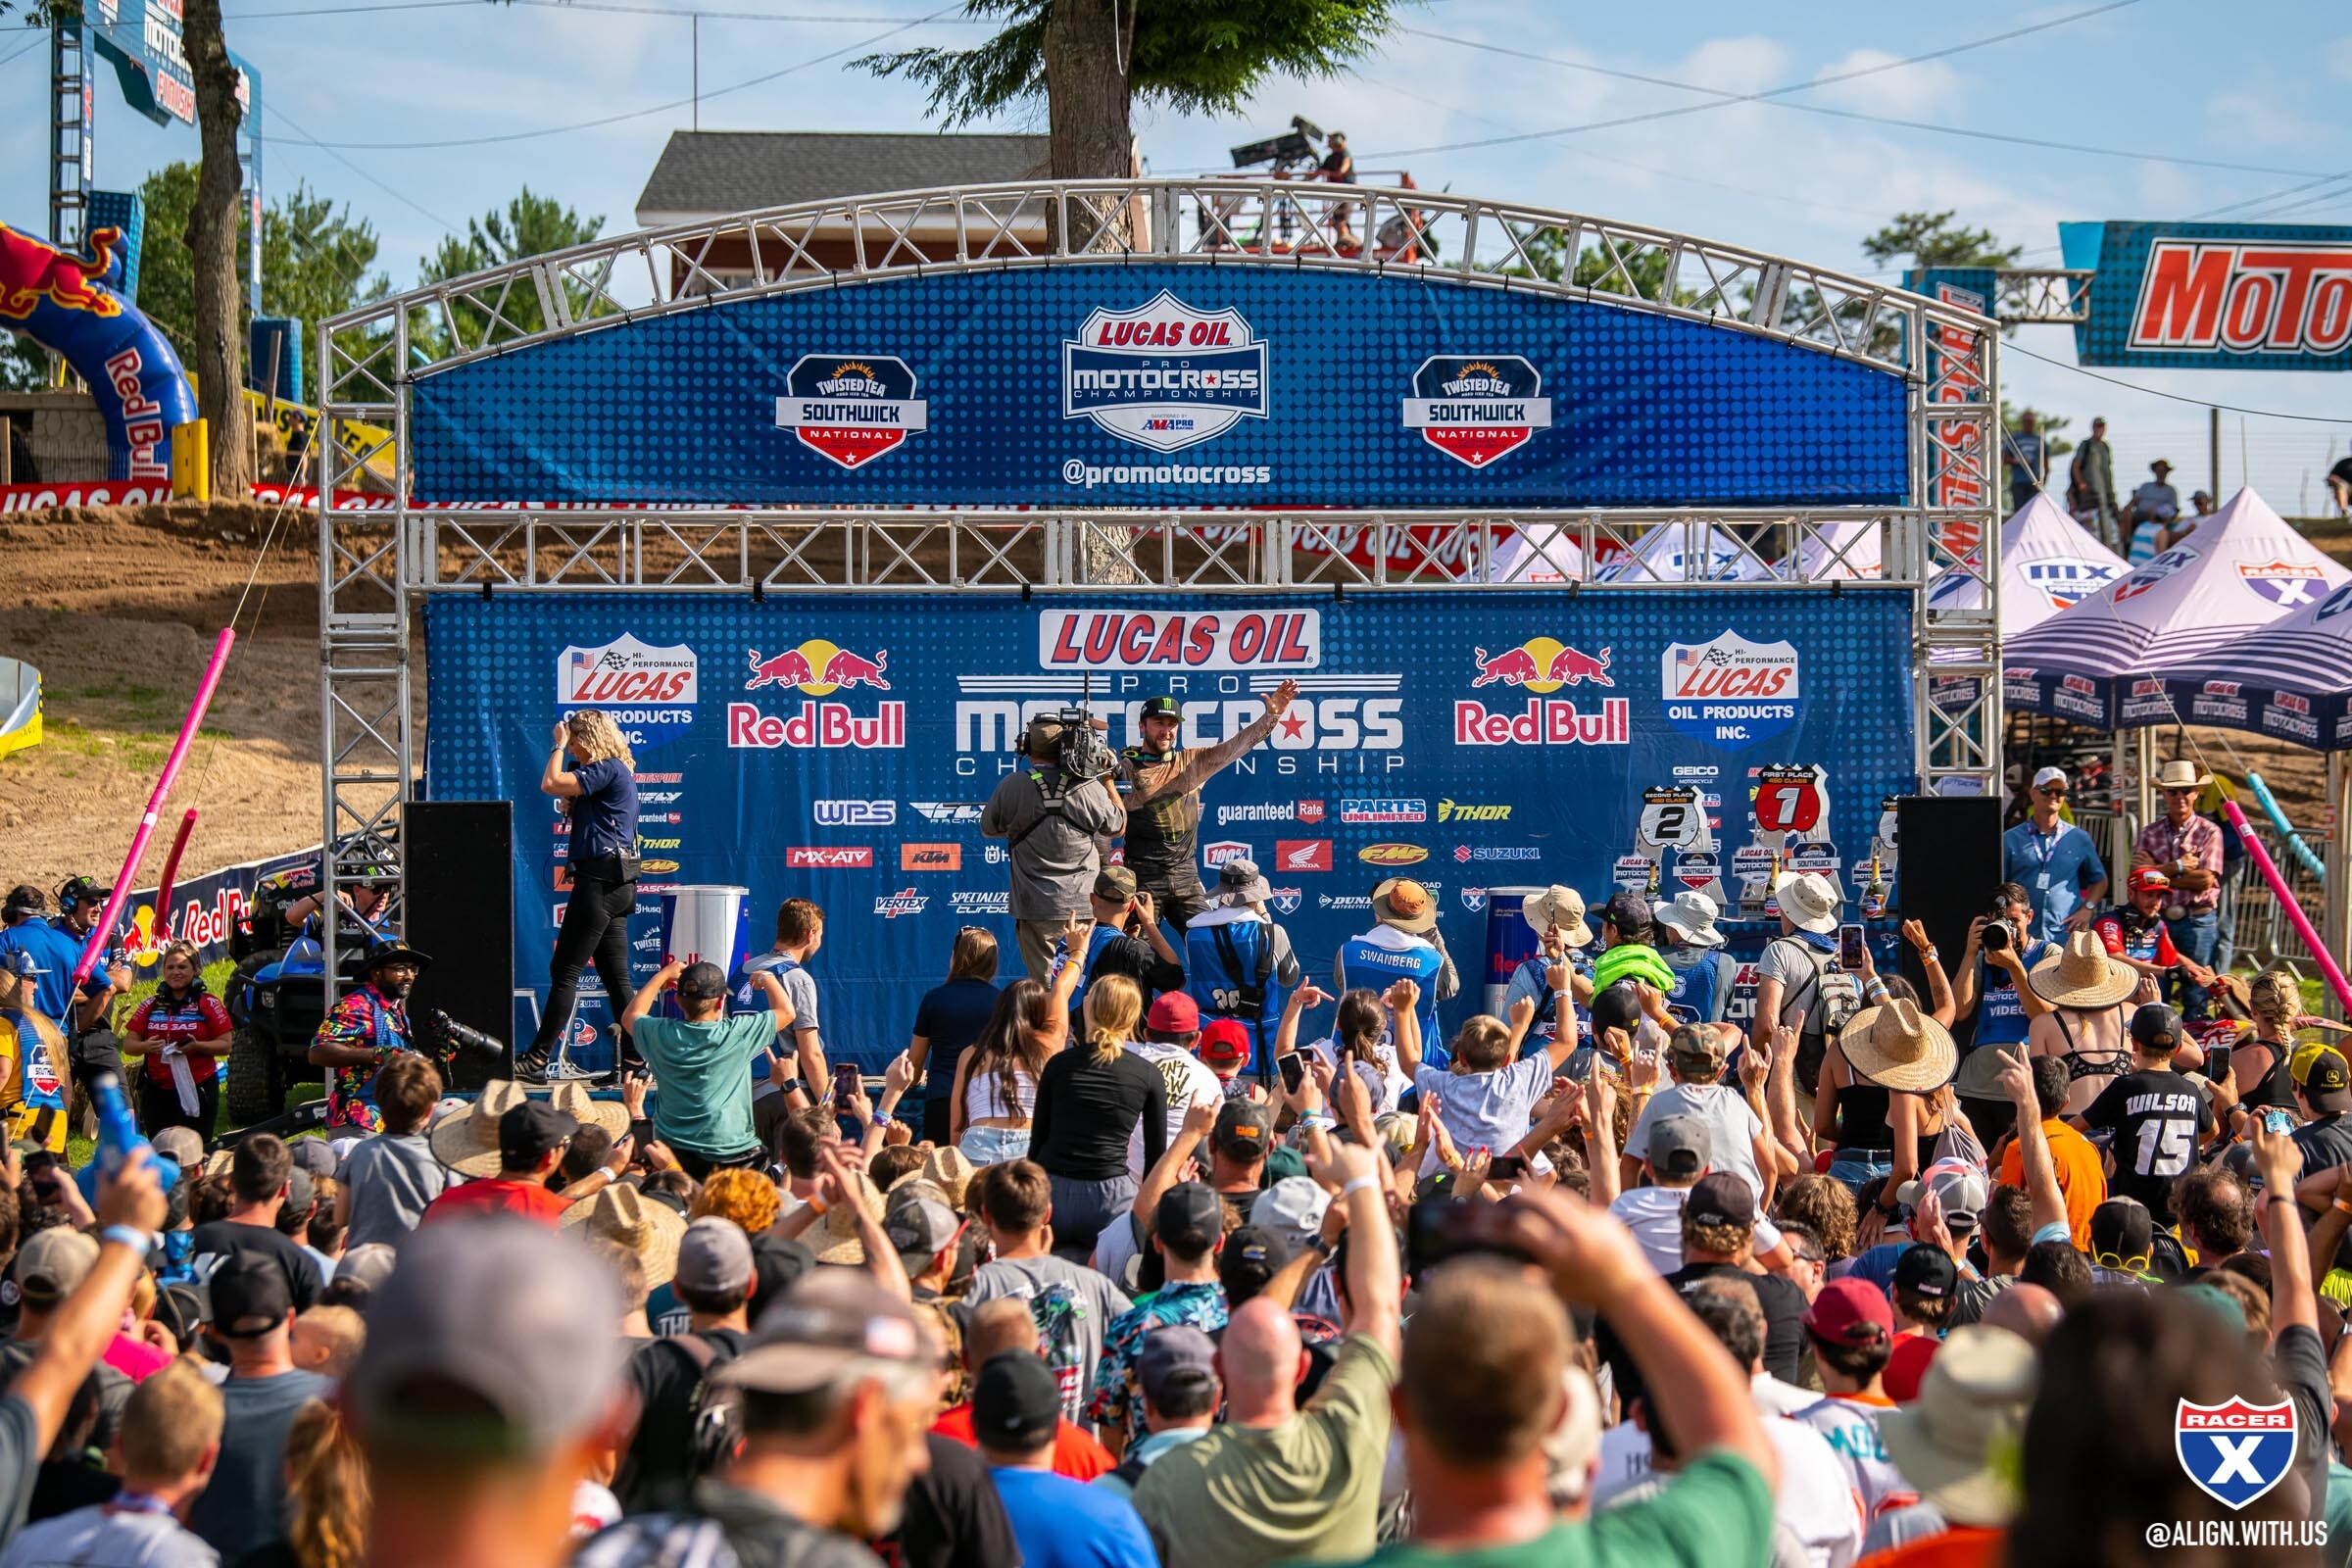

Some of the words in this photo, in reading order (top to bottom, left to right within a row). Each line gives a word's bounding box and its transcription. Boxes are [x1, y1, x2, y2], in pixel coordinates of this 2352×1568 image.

[157, 69, 195, 124] FINISH
[1098, 321, 1185, 346] LUCAS
[1190, 321, 1232, 346] OIL
[105, 347, 161, 419] Red
[816, 378, 864, 396] TWISTED
[864, 378, 887, 397] TEA
[1074, 369, 1258, 389] MOTOCROSS
[1442, 377, 1489, 396] TWISTED
[1489, 377, 1511, 397] TEA
[803, 404, 900, 422] SOUTHWICK
[1429, 404, 1526, 421] SOUTHWICK
[1141, 419, 1176, 430] AMA
[809, 430, 893, 439] NATIONAL
[125, 417, 169, 481] Bull
[1062, 459, 1271, 489] @promotocross
[1051, 613, 1220, 665] LUCAS
[1229, 613, 1309, 663] OIL
[571, 671, 692, 702] LUCAS
[1121, 676, 1240, 694] PRO
[1676, 667, 1792, 697] LUCAS
[1454, 698, 1542, 745] Red
[1545, 698, 1630, 745] Bull
[1669, 707, 1698, 719] OIL
[1702, 706, 1794, 721] PRODUCTS
[728, 701, 816, 748] Red
[820, 701, 906, 748] Bull
[1715, 726, 1750, 740] INC.
[625, 731, 647, 745] NC.
[1673, 766, 1720, 776] GEICO
[814, 800, 897, 825] WPS
[1217, 801, 1294, 826] guaranteed
[1299, 804, 1323, 816] Rate
[1341, 800, 1426, 812] PARTS
[1454, 805, 1513, 820] THOR
[1775, 787, 1800, 825] 1
[637, 812, 667, 822] aranteed
[1341, 812, 1426, 822] UNLIMITED
[1654, 807, 1686, 839] 2
[643, 839, 682, 850] THOR
[1360, 846, 1428, 860] FMF
[793, 851, 824, 863] MX
[832, 851, 869, 863] ATV
[911, 851, 951, 863] KTM
[1473, 848, 1541, 860] SUZUKI
[876, 898, 928, 908] VERTEX
[952, 892, 1009, 903] SPECIALIZE
[1278, 897, 1295, 909] X
[1468, 896, 1481, 907] X
[183, 888, 227, 948] Red
[632, 938, 662, 952] TWISTE
[1359, 949, 1422, 969] SWANBERG
[2126, 1093, 2197, 1116] WILSON
[2134, 1119, 2196, 1176] 15
